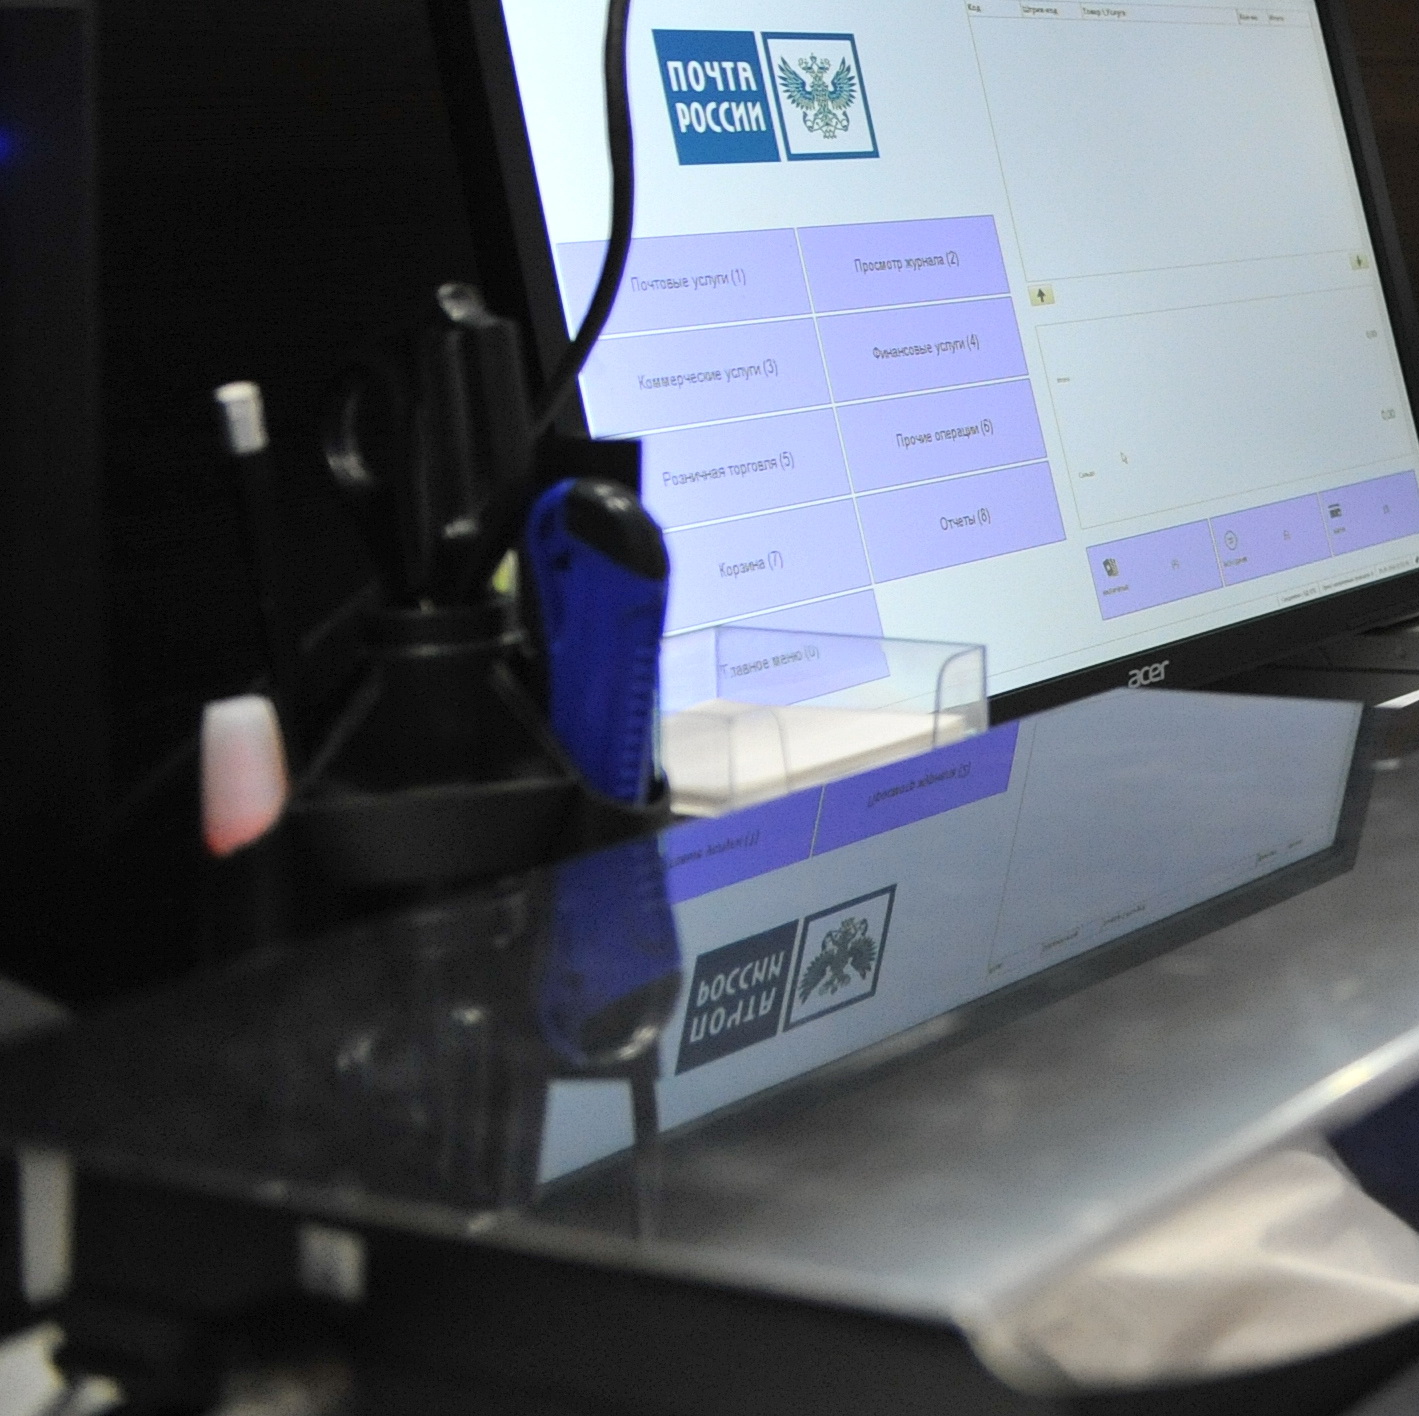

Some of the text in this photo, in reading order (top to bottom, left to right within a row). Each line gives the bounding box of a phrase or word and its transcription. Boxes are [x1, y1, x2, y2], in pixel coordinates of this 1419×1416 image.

[666, 60, 758, 92] ПОЧТА
[675, 101, 767, 133] РОССИИ
[854, 250, 960, 274] Просмотр журнала (2)
[630, 268, 747, 292] Почтовые услуги (1)
[872, 333, 980, 360] Финансовые услуги (4)
[637, 358, 779, 390] Коммерческие услуги (3)
[896, 418, 994, 451] Прочие операции (6)
[662, 451, 795, 487] Розничная торговля (5)
[940, 507, 991, 531] Отчеты (8)
[718, 550, 784, 579] Корзина (7)
[1128, 659, 1169, 689] acer
